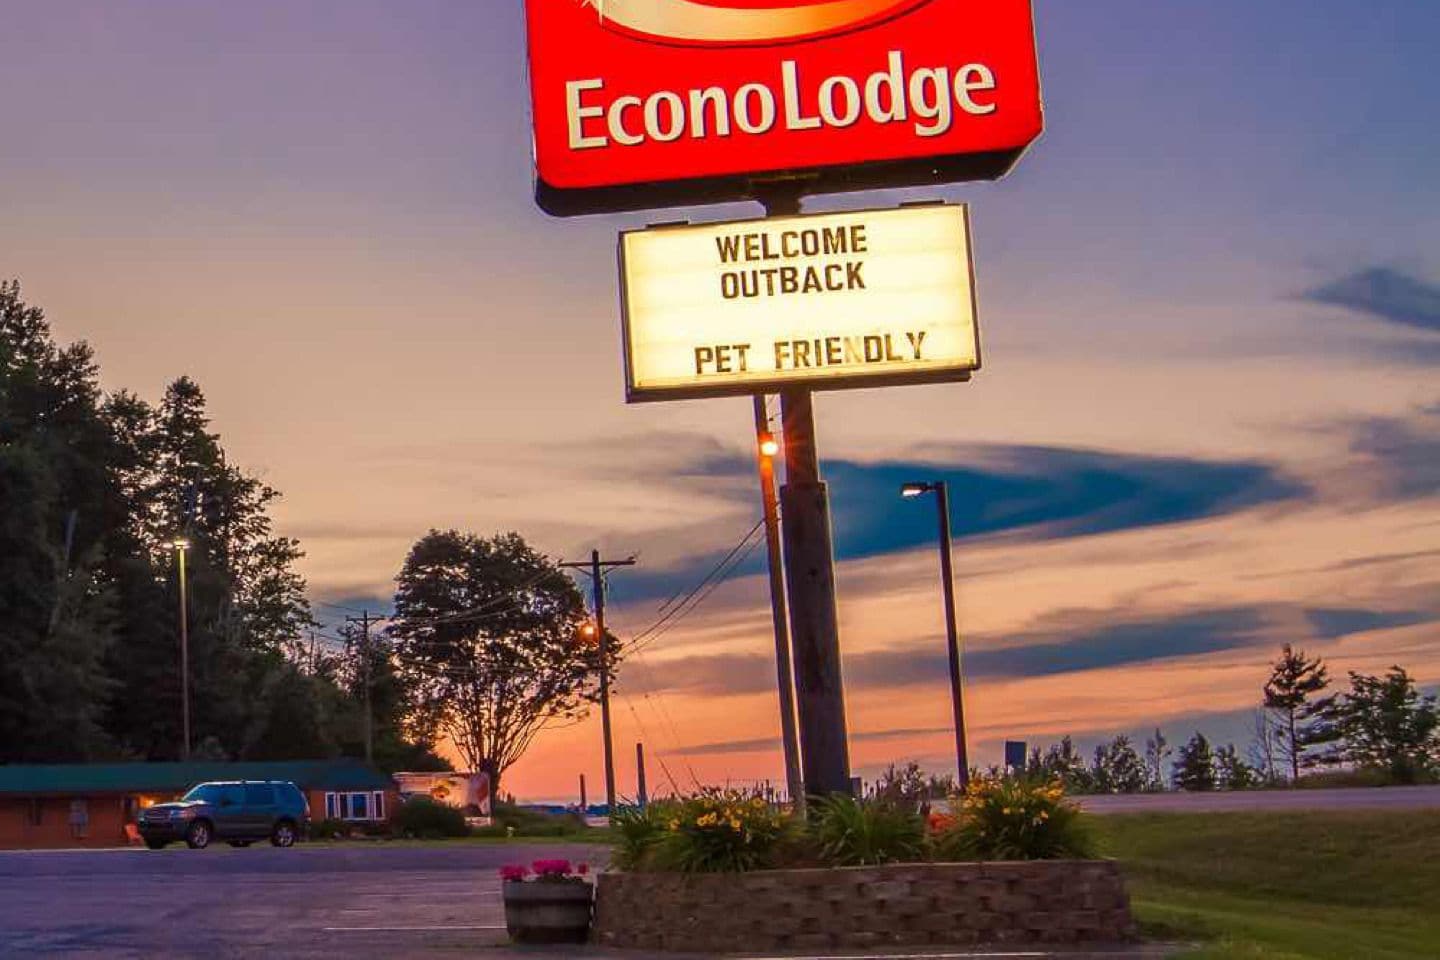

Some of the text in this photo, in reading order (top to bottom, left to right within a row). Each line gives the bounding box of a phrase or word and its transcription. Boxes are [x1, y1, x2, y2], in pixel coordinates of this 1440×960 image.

[565, 50, 996, 149] EconoLodge
[716, 225, 868, 263] WELCOME
[720, 261, 866, 300] OUTBACK
[694, 331, 926, 375] PET FRIENDLY
